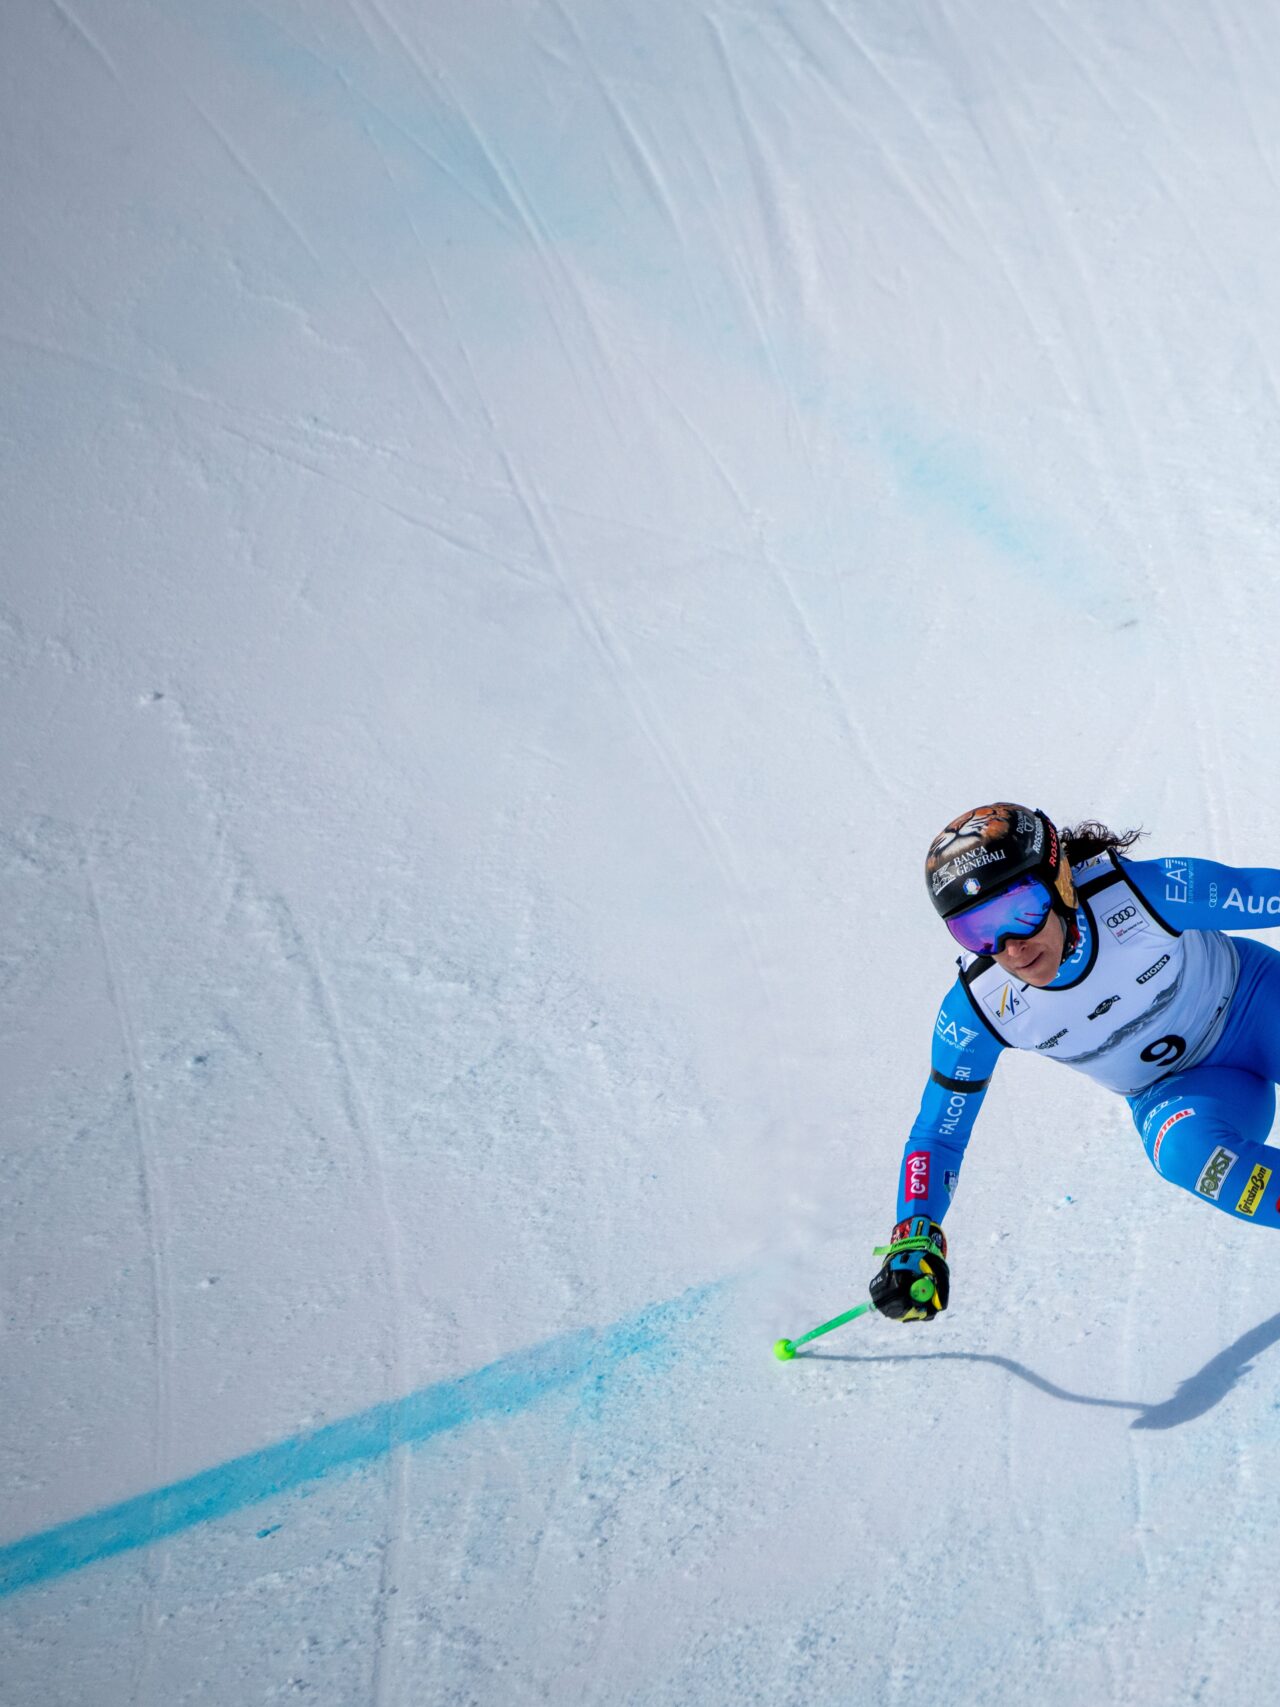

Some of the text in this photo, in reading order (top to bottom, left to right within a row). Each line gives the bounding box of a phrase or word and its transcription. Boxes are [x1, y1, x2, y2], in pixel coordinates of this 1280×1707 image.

[953, 846, 988, 867] BANCA
[956, 849, 1007, 876] GENERALI
[1138, 956, 1169, 982] THOMY
[936, 1009, 980, 1048] EA7
[1140, 1034, 1187, 1067] 9
[939, 1066, 972, 1135] FALCORI
[911, 1156, 927, 1194] enel
[1199, 1149, 1234, 1198] FORST
